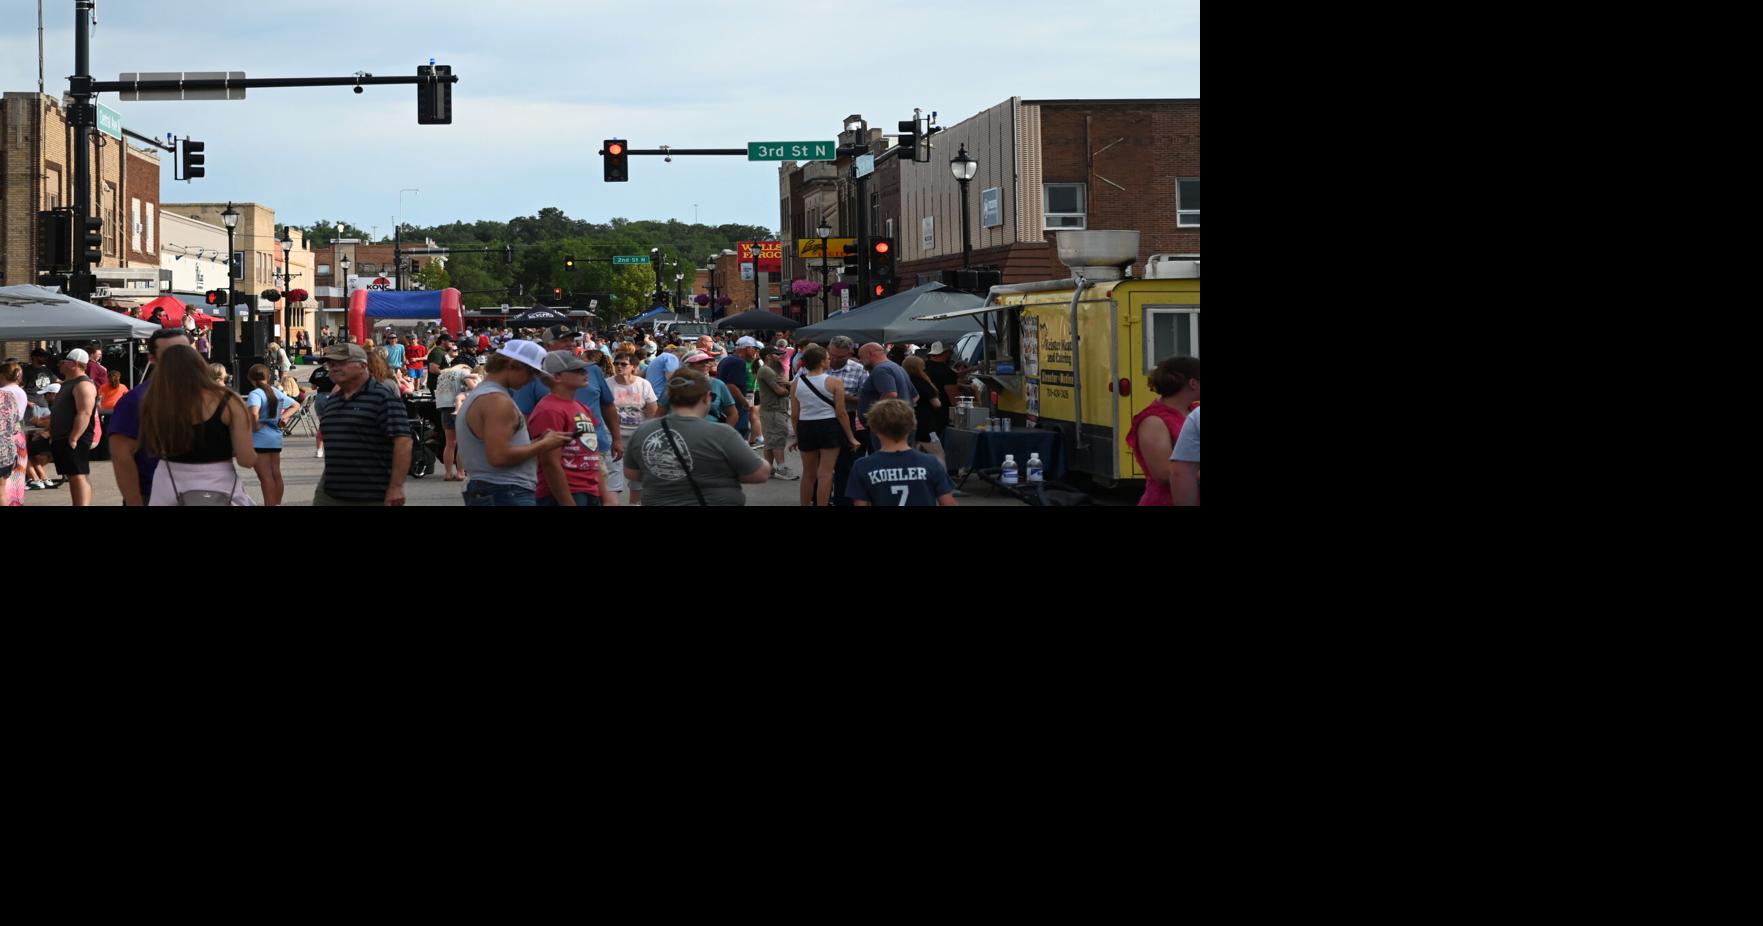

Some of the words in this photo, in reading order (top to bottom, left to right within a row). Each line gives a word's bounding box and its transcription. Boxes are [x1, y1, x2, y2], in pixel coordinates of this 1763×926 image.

[758, 146, 784, 157] 3rd
[792, 145, 808, 156] St
[815, 145, 826, 156] N
[868, 467, 927, 484] KOHLER
[890, 485, 909, 506] 7
